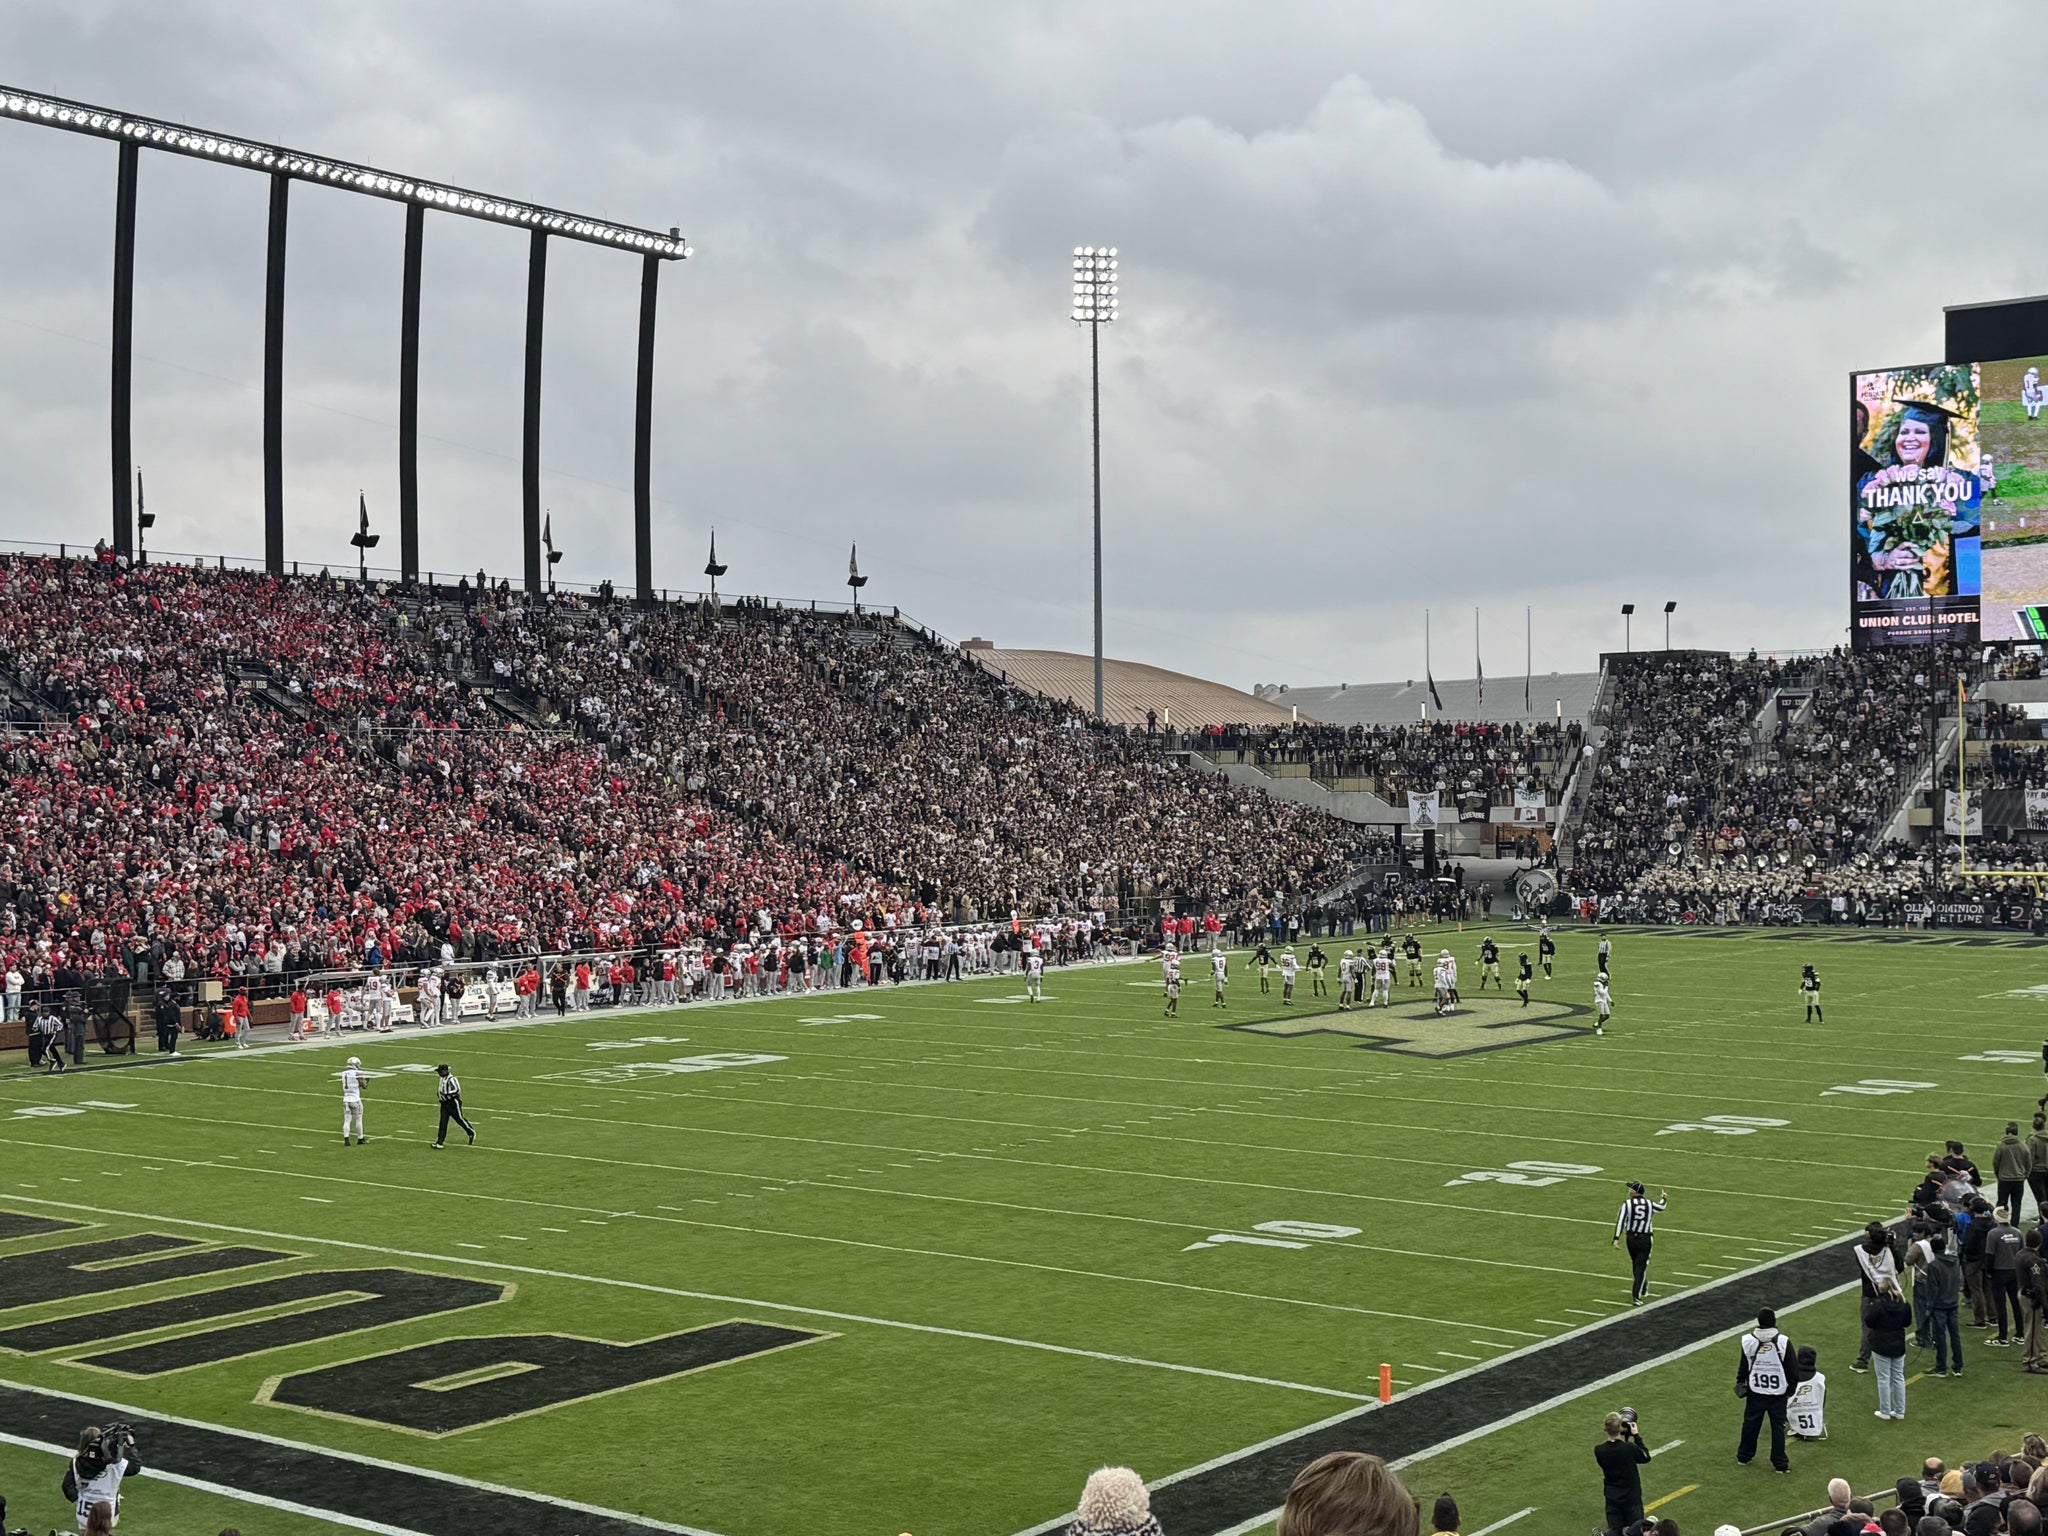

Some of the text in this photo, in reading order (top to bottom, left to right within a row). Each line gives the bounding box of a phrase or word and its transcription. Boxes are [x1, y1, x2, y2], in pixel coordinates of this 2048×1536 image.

[1895, 467, 1943, 483] we say
[1865, 481, 1972, 508] THANK YOU
[1859, 616, 1899, 628] UNION
[1938, 612, 1980, 624] HOTEL
[1957, 914, 1983, 924] LINE
[1634, 1205, 1646, 1220] S
[1753, 1373, 1780, 1389] 199
[1798, 1414, 1815, 1429] 51
